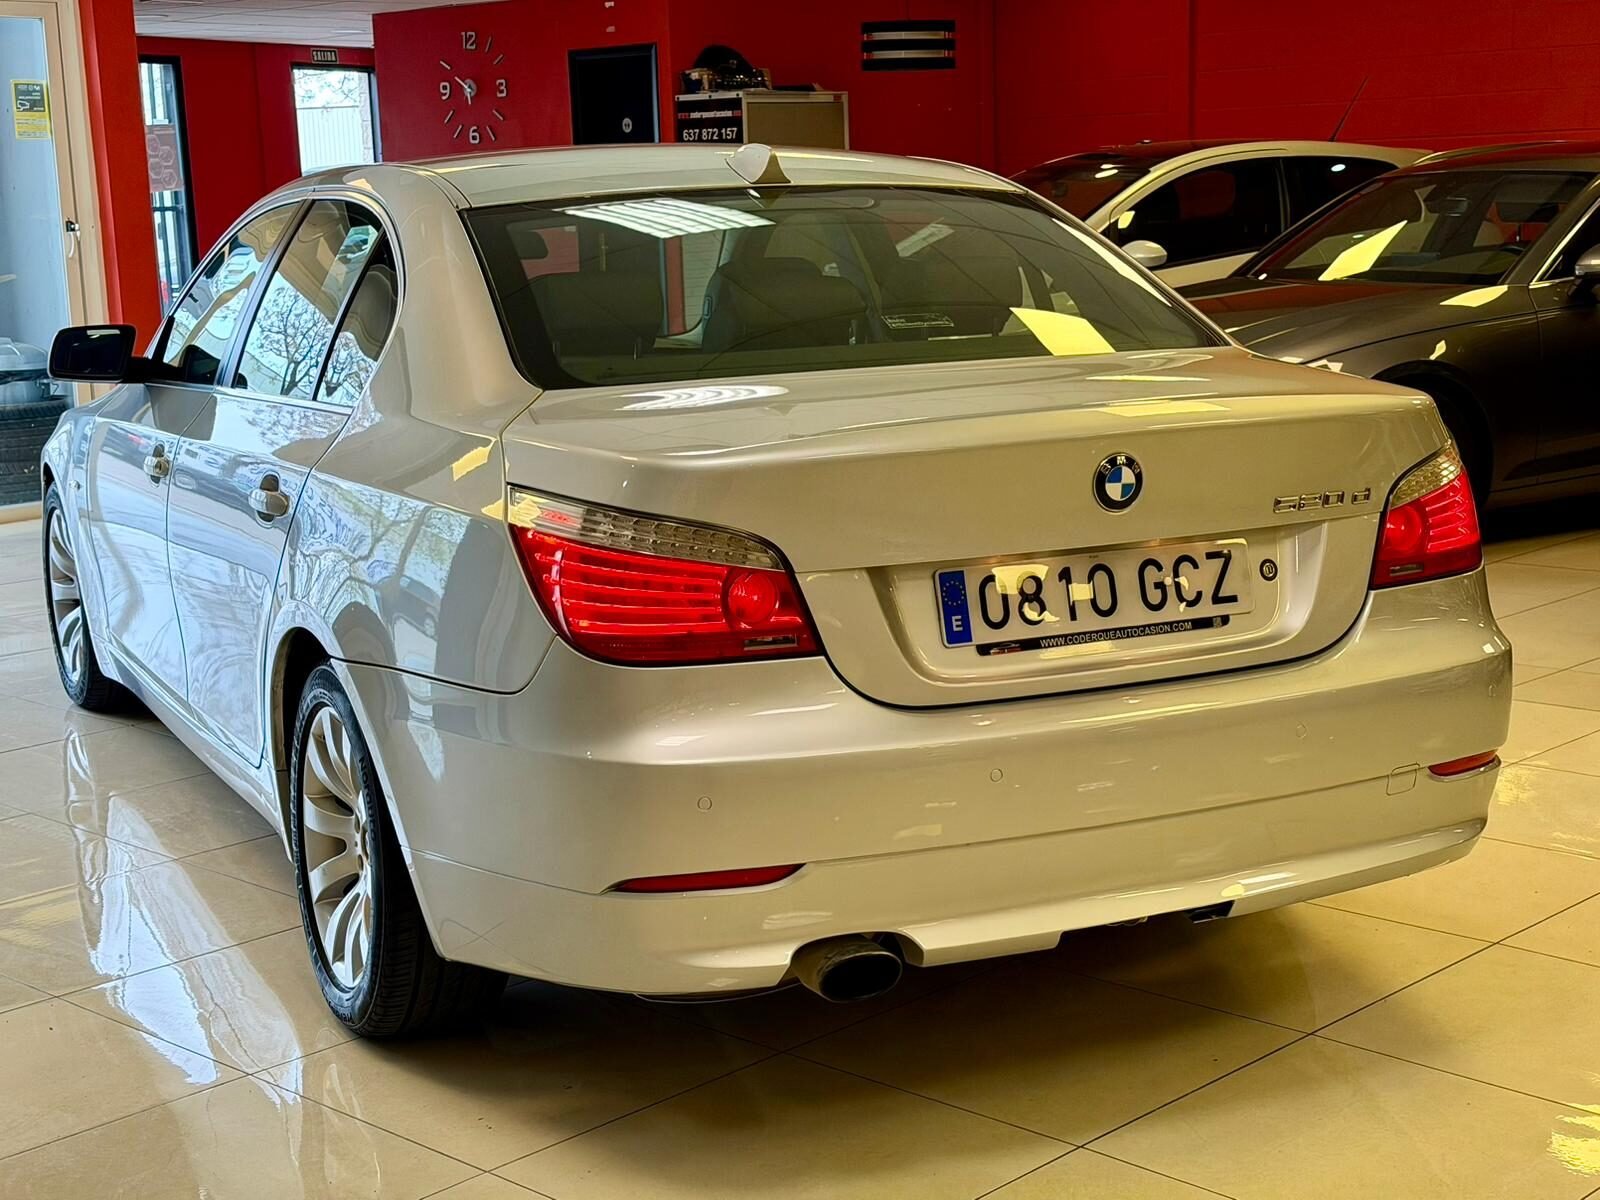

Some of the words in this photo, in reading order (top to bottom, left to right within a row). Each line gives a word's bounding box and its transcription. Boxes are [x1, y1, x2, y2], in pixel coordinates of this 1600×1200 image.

[461, 31, 476, 49] 12
[440, 82, 450, 100] 9
[496, 79, 507, 97] 3
[469, 126, 480, 144] 6
[683, 129, 700, 141] 637
[702, 128, 719, 140] 872
[721, 127, 738, 139] 157
[978, 562, 1118, 630] 0810
[1137, 549, 1239, 613] GCZ
[952, 615, 964, 633] E
[1039, 621, 1193, 648] WWW.CODERQUEAUTOCASION.COM
